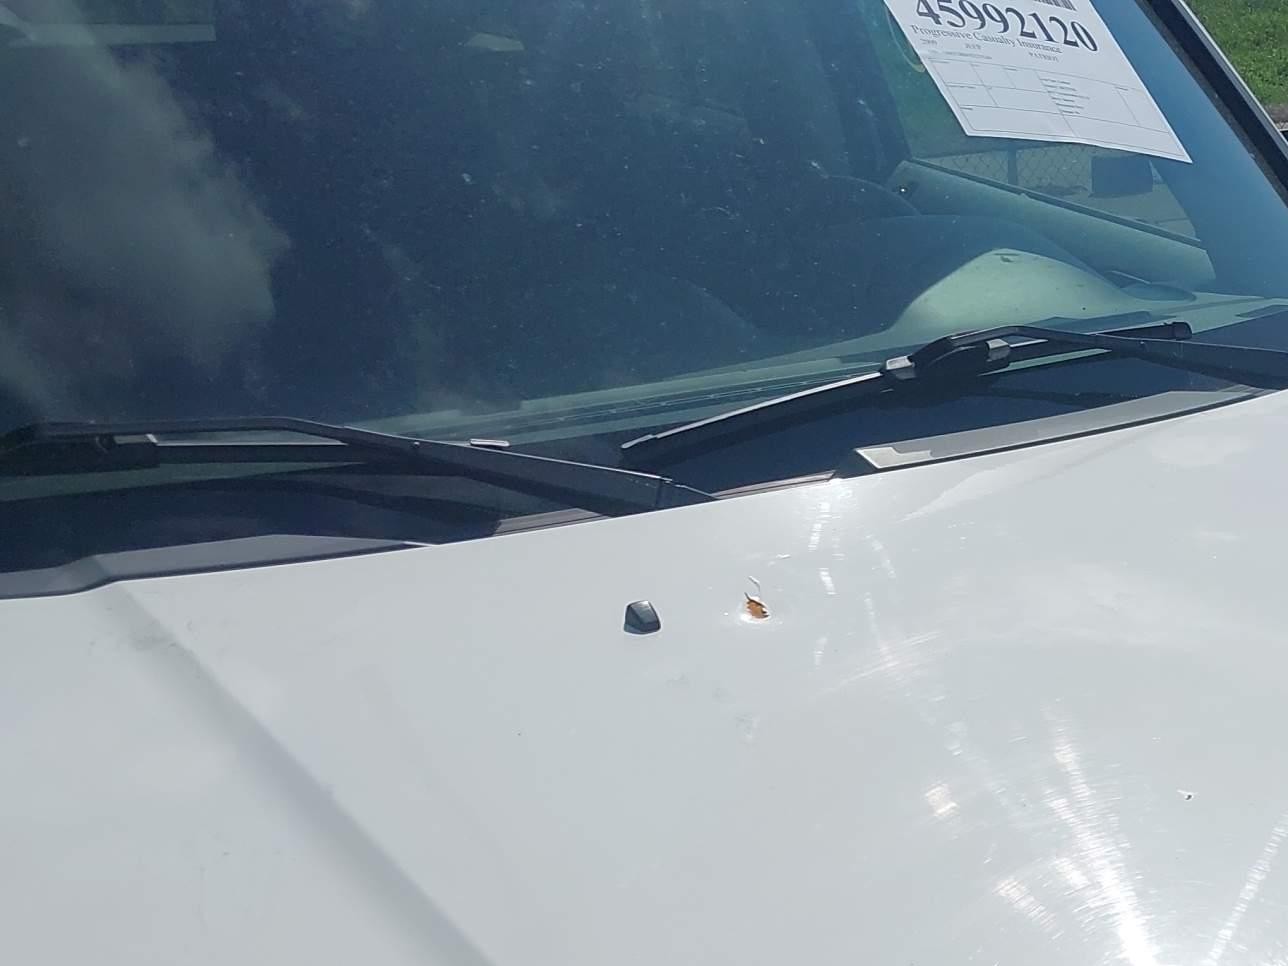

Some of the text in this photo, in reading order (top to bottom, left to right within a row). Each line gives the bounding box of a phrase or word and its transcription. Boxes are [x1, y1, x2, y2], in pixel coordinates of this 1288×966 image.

[911, 24, 1062, 53] Progressive Casualty Insurance
[916, 0, 1098, 52] 45992120
